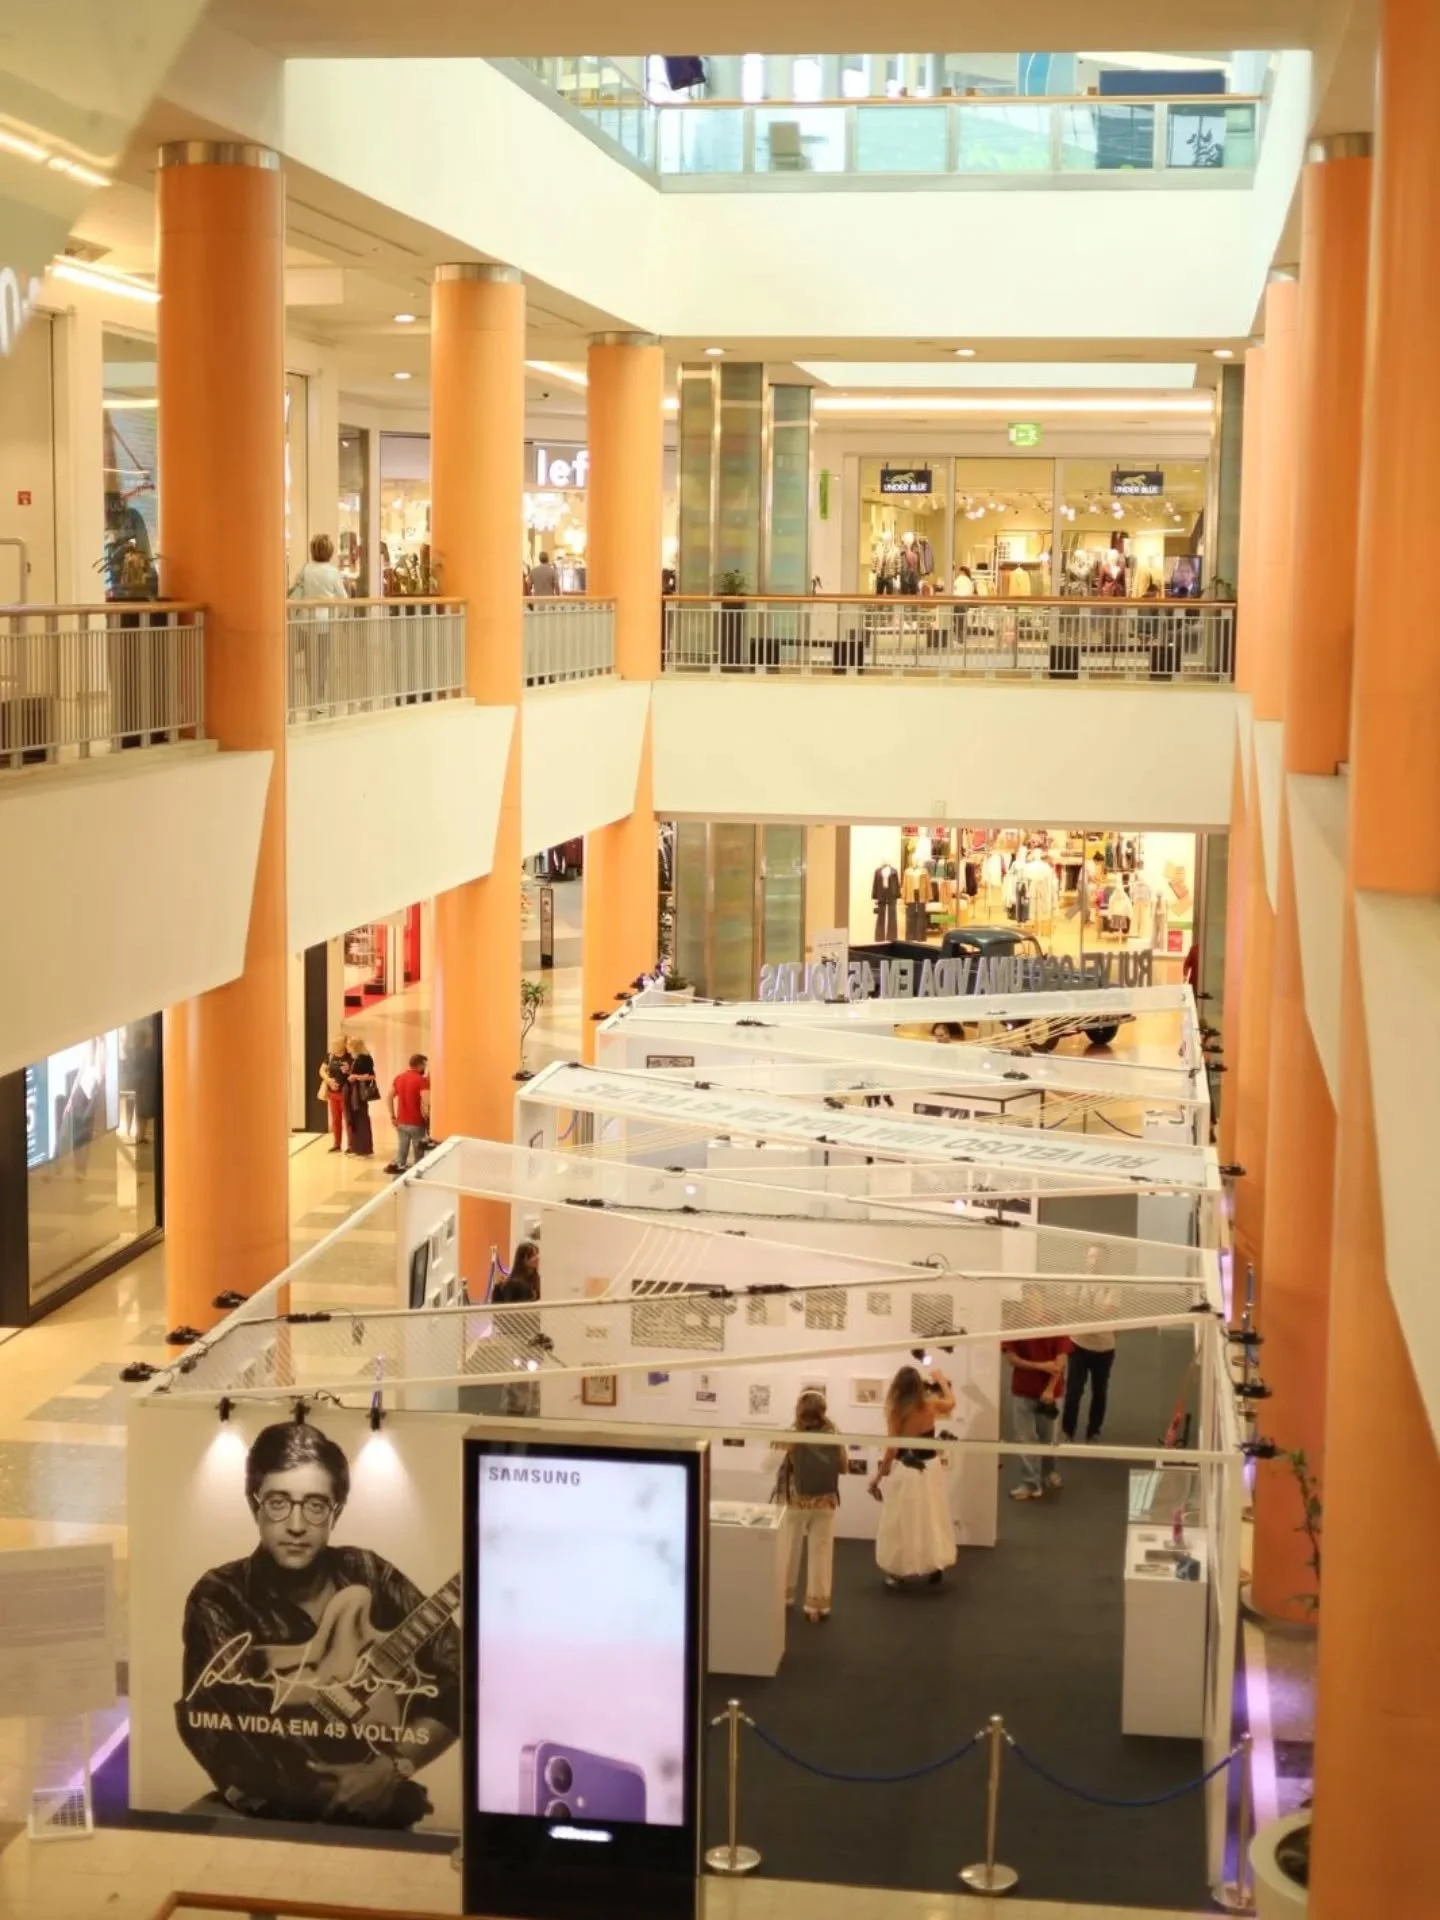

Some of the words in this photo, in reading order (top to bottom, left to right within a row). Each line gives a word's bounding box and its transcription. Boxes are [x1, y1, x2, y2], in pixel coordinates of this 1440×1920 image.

[883, 483, 908, 492] UNDER
[942, 1138, 1084, 1162] VELOSO
[1080, 1153, 1159, 1170] RUI
[488, 1466, 581, 1487] SAMSUNG
[188, 1712, 233, 1730] UMA
[239, 1715, 282, 1734] VIDA
[289, 1719, 319, 1737] EM
[323, 1721, 346, 1739] 45
[351, 1723, 430, 1745] VOLTAS
